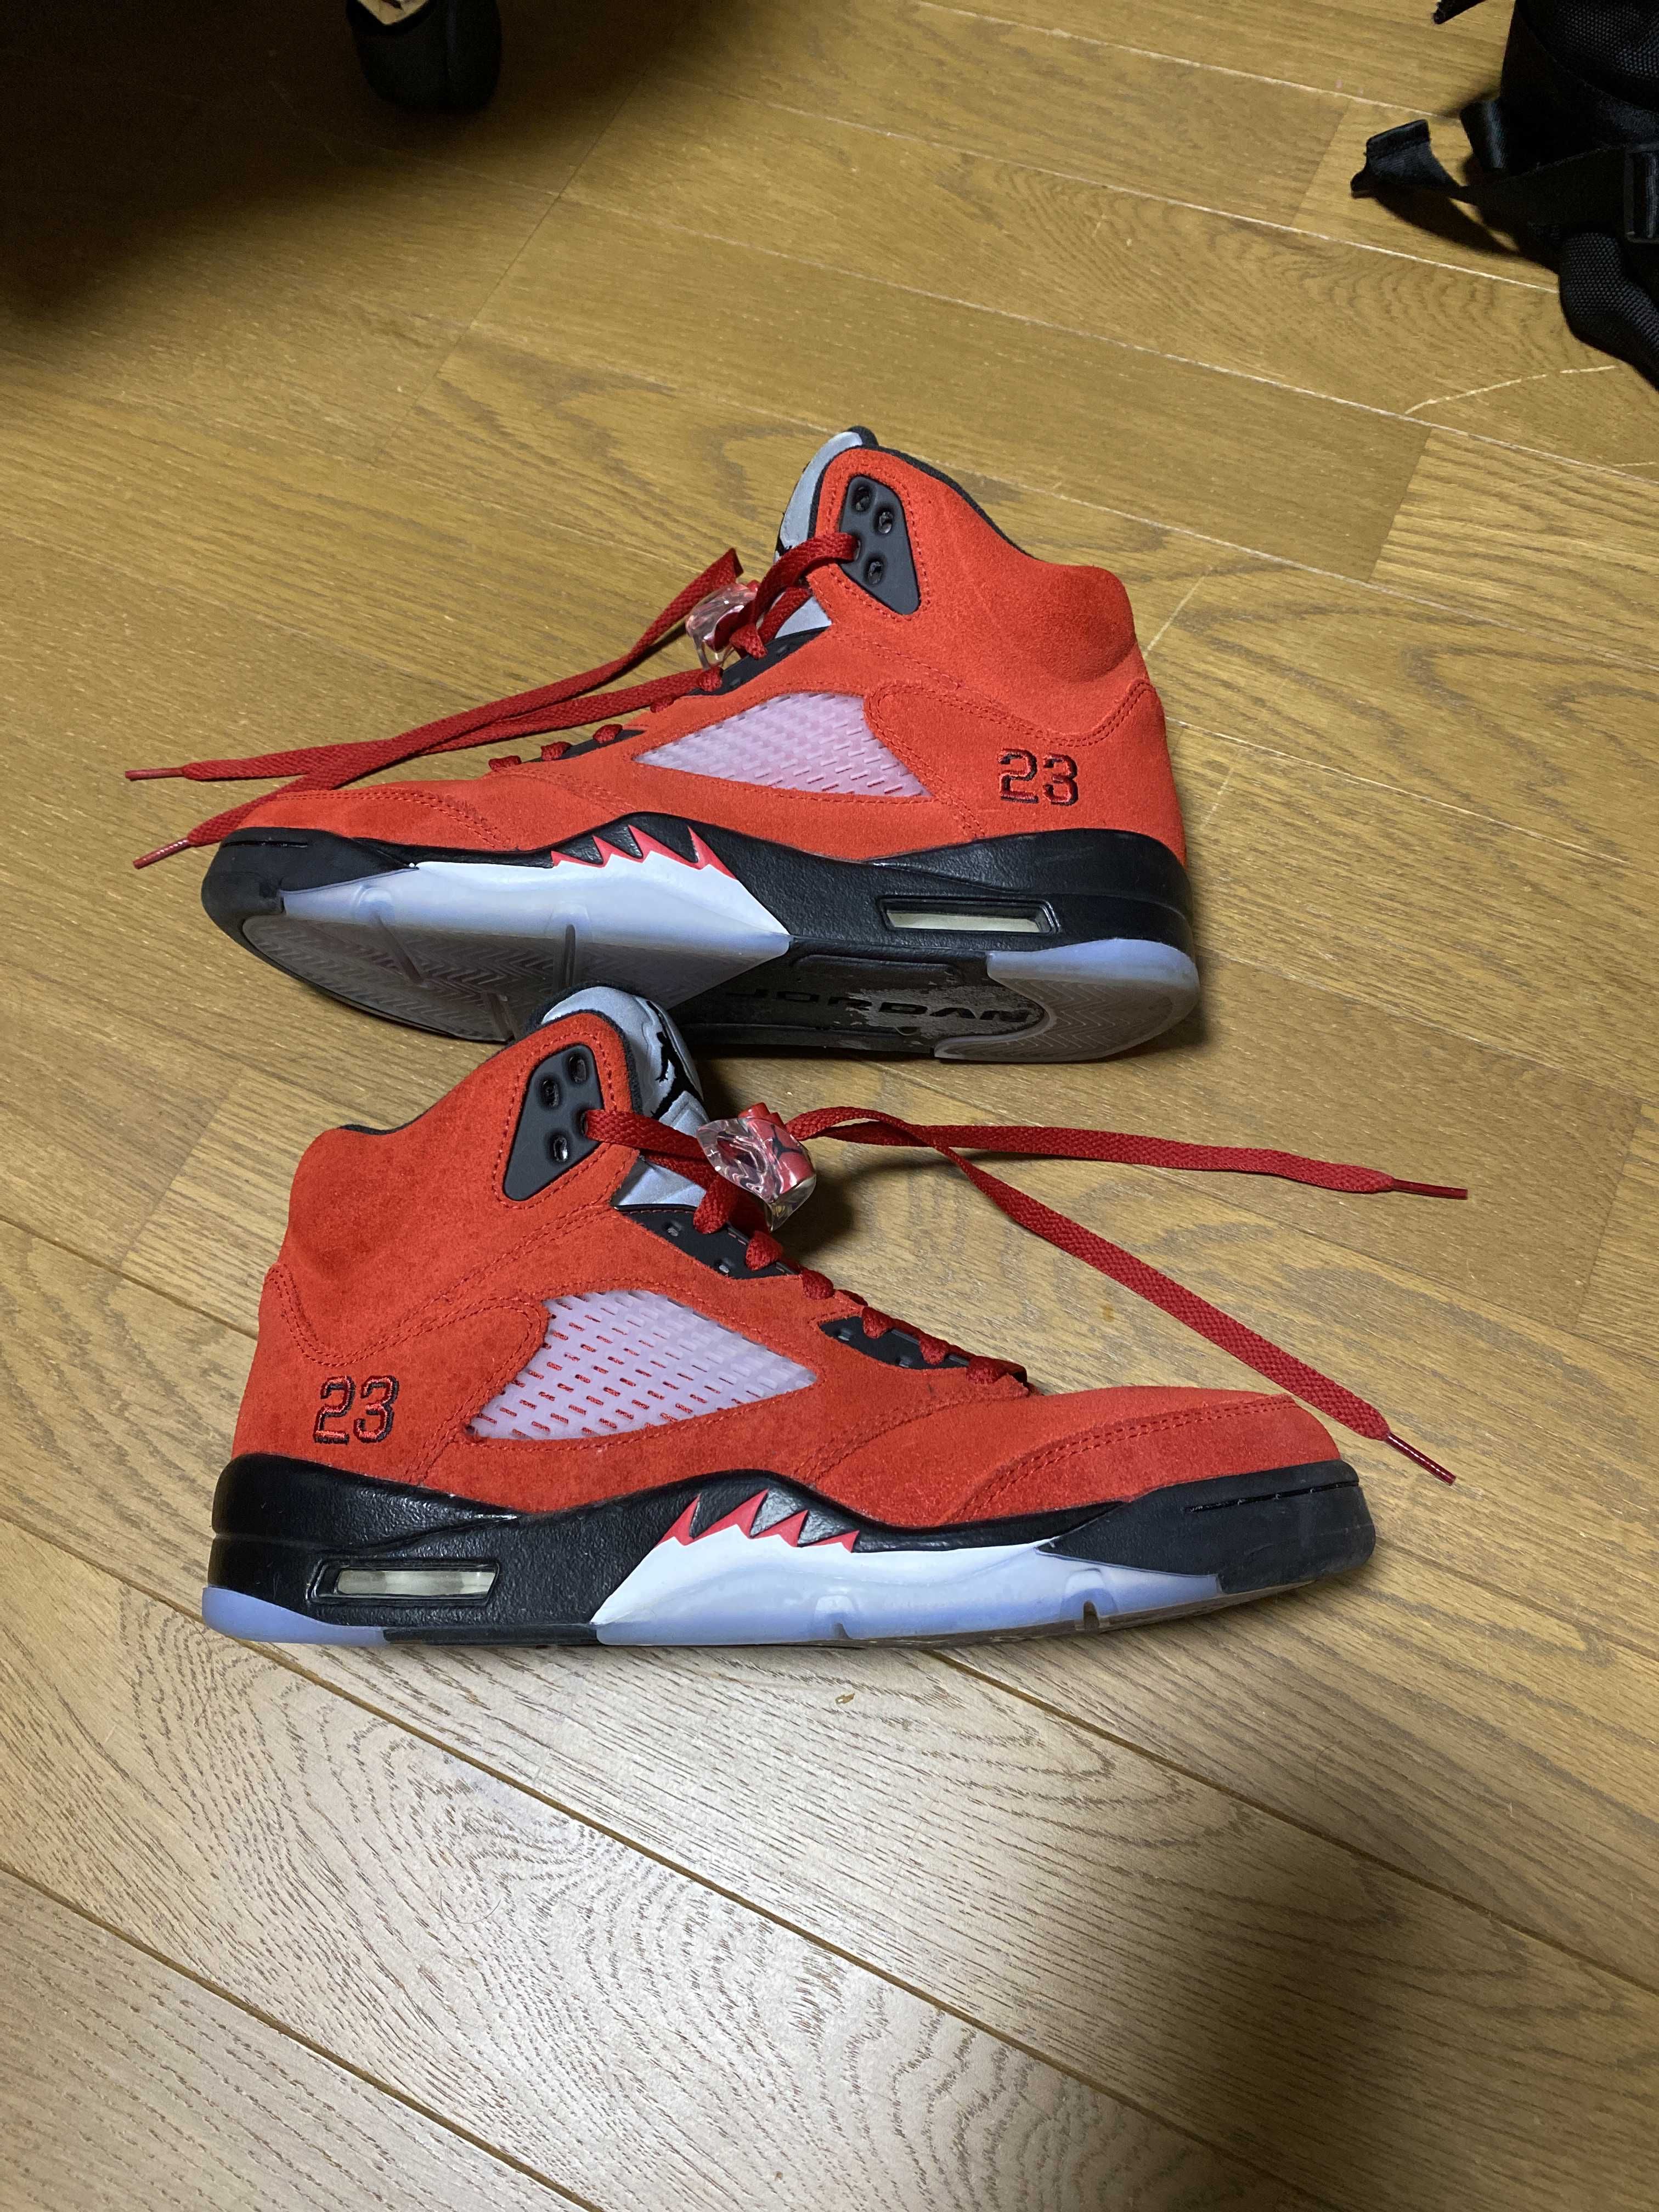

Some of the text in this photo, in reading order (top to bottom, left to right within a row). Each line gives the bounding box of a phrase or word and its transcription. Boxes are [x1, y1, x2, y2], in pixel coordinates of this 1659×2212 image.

[997, 748, 1079, 806] 23
[726, 989, 1029, 1023] JORDAN
[313, 1375, 399, 1445] 23
